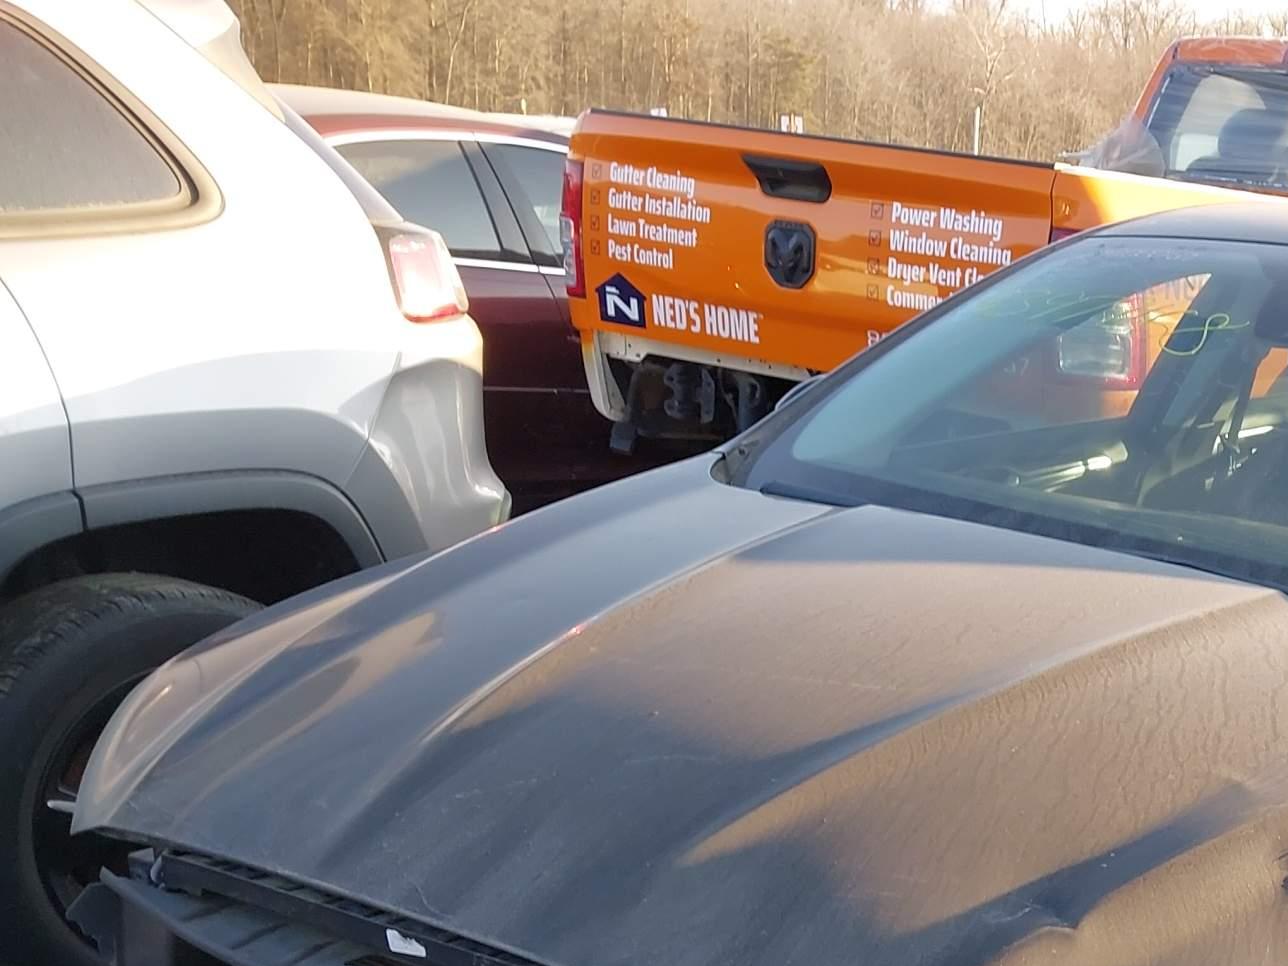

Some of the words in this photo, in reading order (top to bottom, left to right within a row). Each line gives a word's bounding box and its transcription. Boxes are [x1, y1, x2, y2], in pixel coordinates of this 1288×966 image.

[609, 161, 645, 186] Gutter
[646, 167, 696, 199] Cleaning
[608, 187, 644, 212] Gutter
[644, 193, 711, 224] Installation
[891, 201, 937, 229] Power
[939, 206, 1003, 242] Washing
[607, 212, 636, 238] Lawn
[638, 218, 698, 248] Treatment
[889, 228, 948, 258] Window
[949, 236, 1012, 266] Cleaning
[607, 239, 632, 262] Pest
[633, 243, 673, 270] Control
[887, 256, 927, 286] Dryer
[928, 262, 962, 288] Vent
[651, 293, 701, 334] NED'S
[703, 303, 761, 344] HOME
